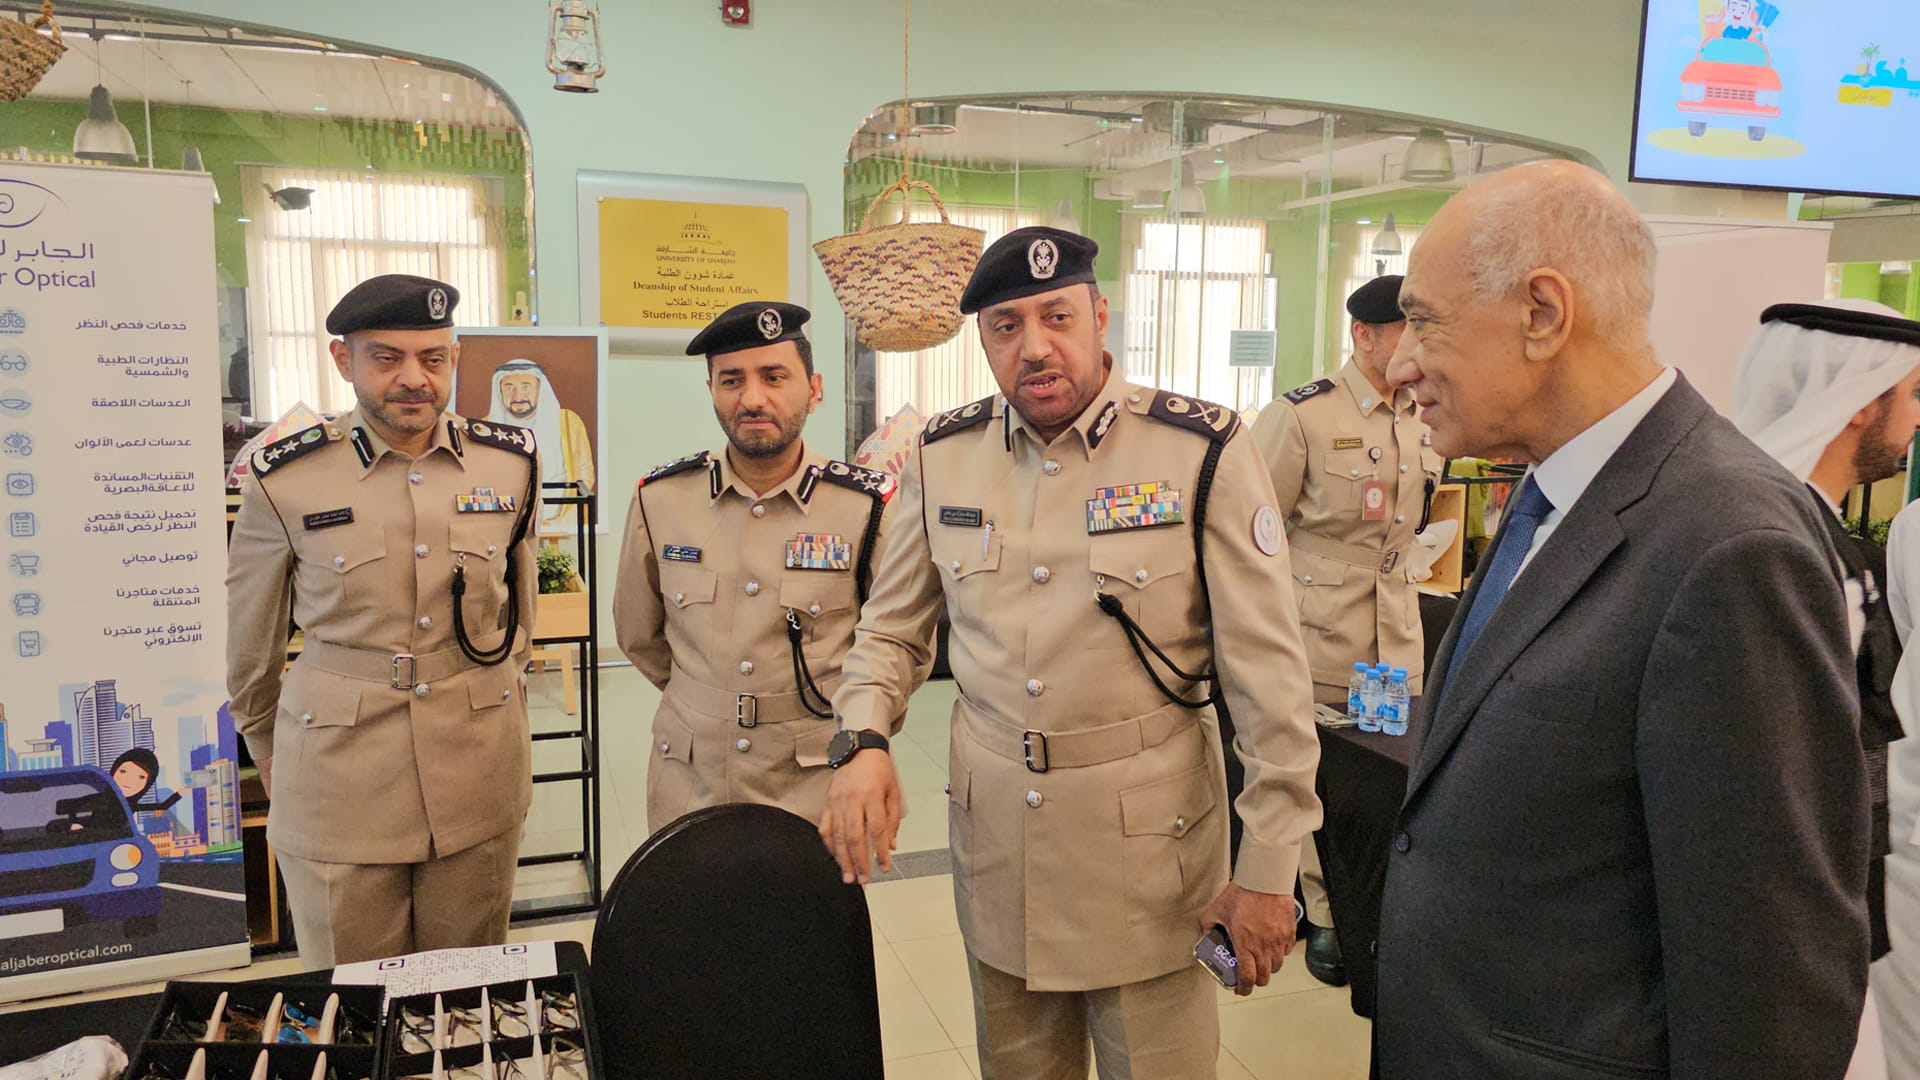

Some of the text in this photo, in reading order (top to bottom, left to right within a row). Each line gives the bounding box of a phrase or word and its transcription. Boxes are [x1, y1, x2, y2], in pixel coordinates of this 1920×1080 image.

[14, 240, 94, 263] الجابر
[656, 255, 695, 263] UNIVERSITY
[14, 267, 96, 292] Optical
[633, 281, 759, 295] Deanship of Student Affairs
[642, 310, 688, 320] Students
[75, 319, 187, 331] خدمات فحص النظر
[97, 354, 189, 367] النظارات الطبية
[125, 366, 190, 379] والشمسية
[91, 397, 191, 408] العدسات اللاصقة
[115, 438, 147, 449] لعمى
[148, 437, 192, 447] عدسات
[94, 471, 194, 482] التقنيات المساندة
[103, 483, 148, 496] البصرية
[87, 508, 197, 523] تحميل نتيجة فحص
[84, 520, 197, 535] النظر لرخص القيادة
[122, 550, 198, 568] توصيل مجاني
[116, 584, 200, 599] خدمات متاجرنا
[152, 596, 200, 607] المتنقلة
[103, 621, 202, 638] تسوق عبر متجرنا
[0, 943, 133, 972] aljaberoptical.com
